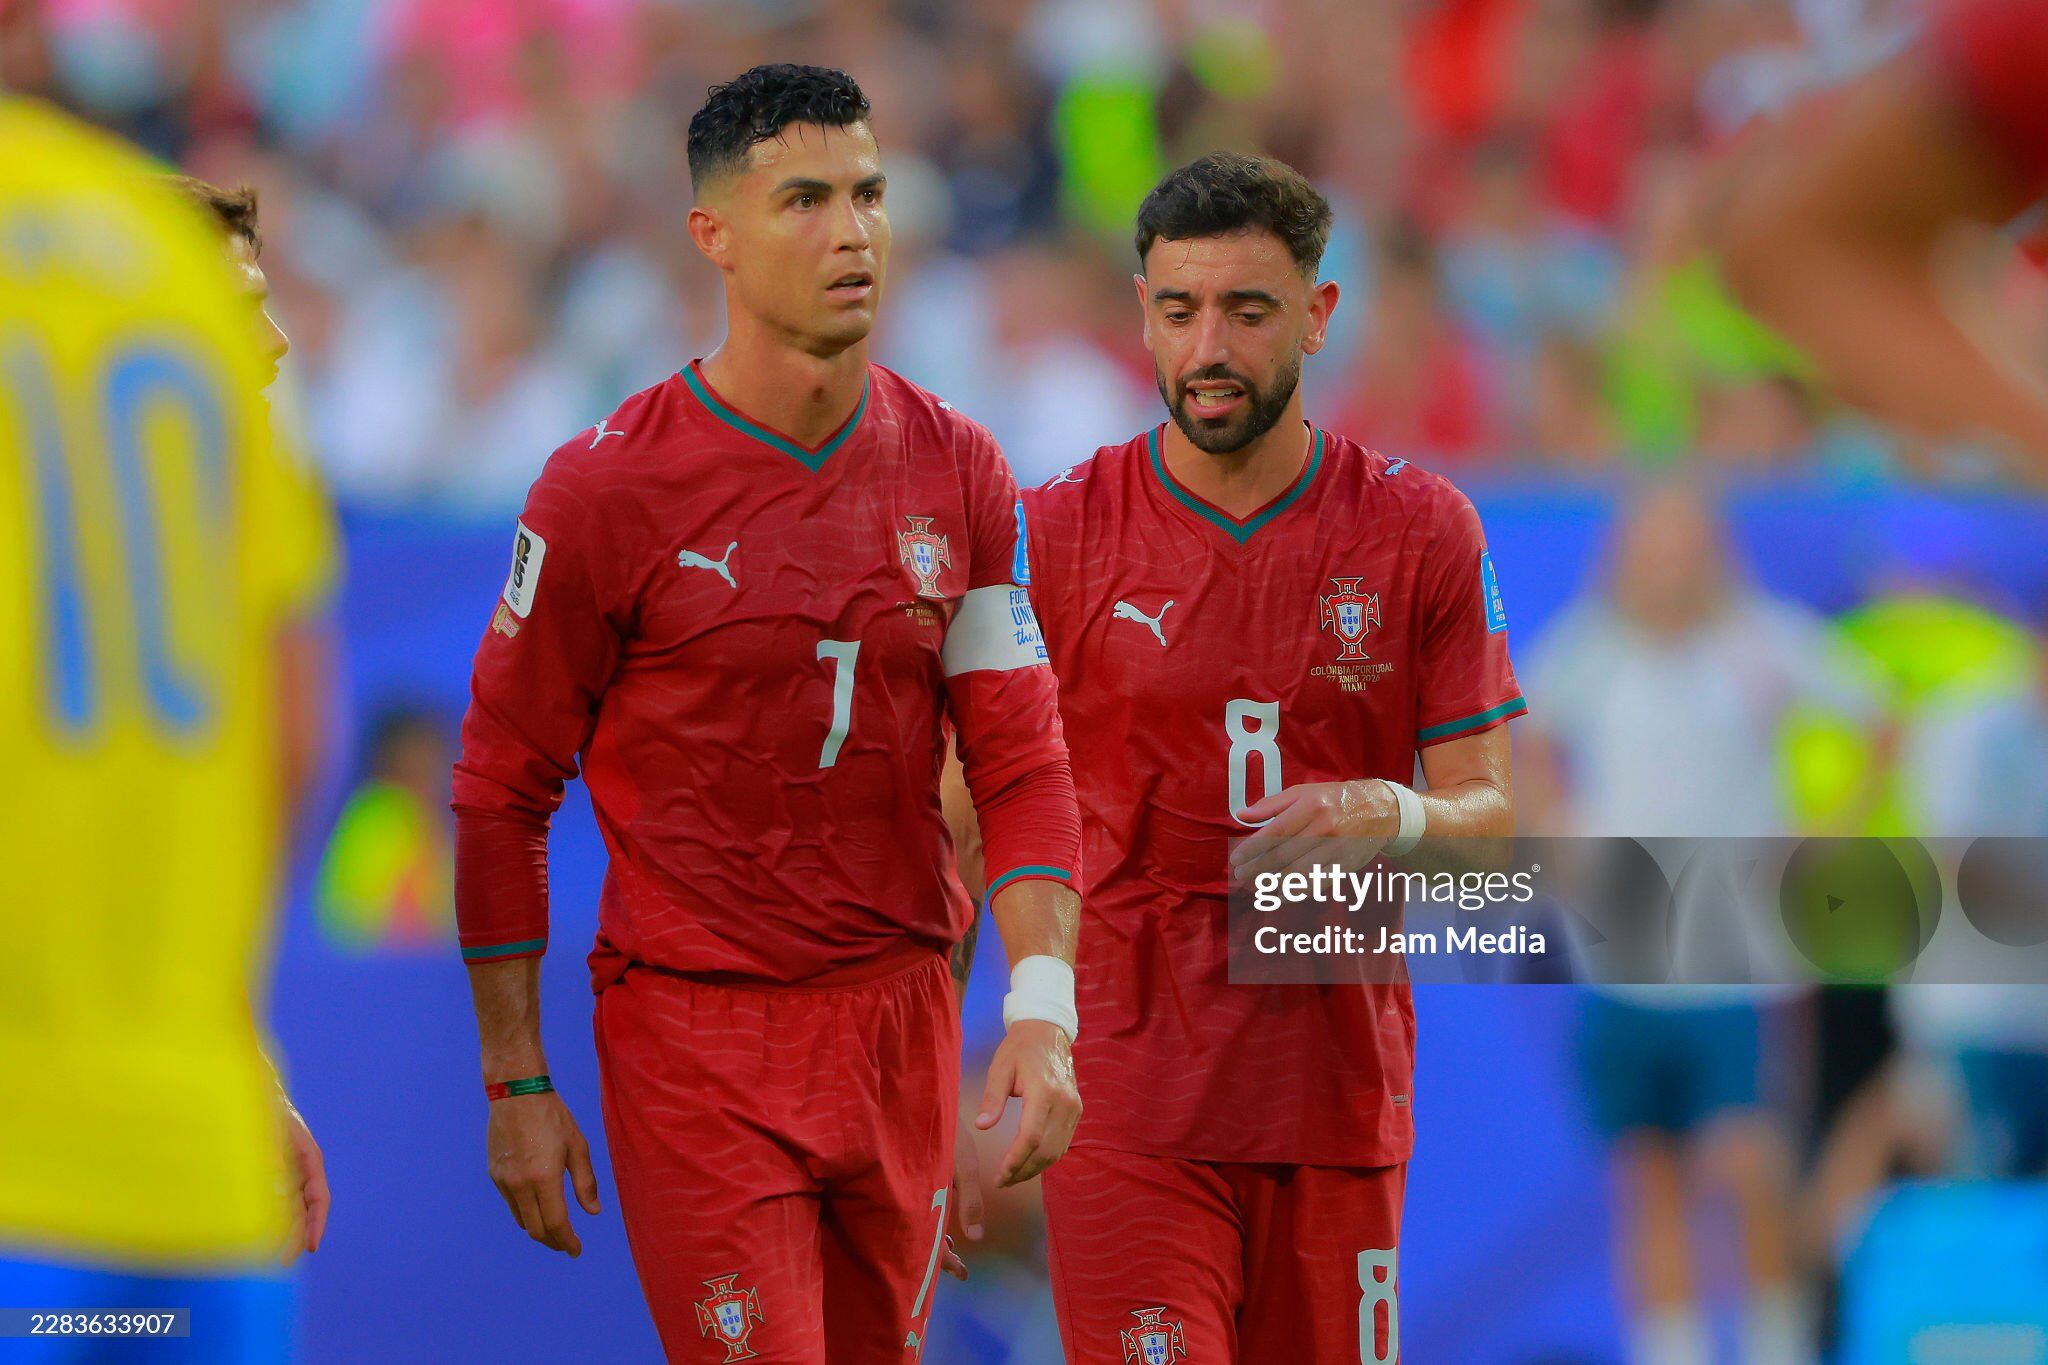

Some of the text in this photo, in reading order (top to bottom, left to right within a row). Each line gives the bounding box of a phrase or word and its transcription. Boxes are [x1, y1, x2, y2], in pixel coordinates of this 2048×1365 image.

[816, 639, 861, 769] 7
[1341, 682, 1366, 693] MIAMI
[1226, 699, 1283, 827] 8
[911, 1187, 948, 1318] 7
[1357, 1246, 1399, 1365] 8
